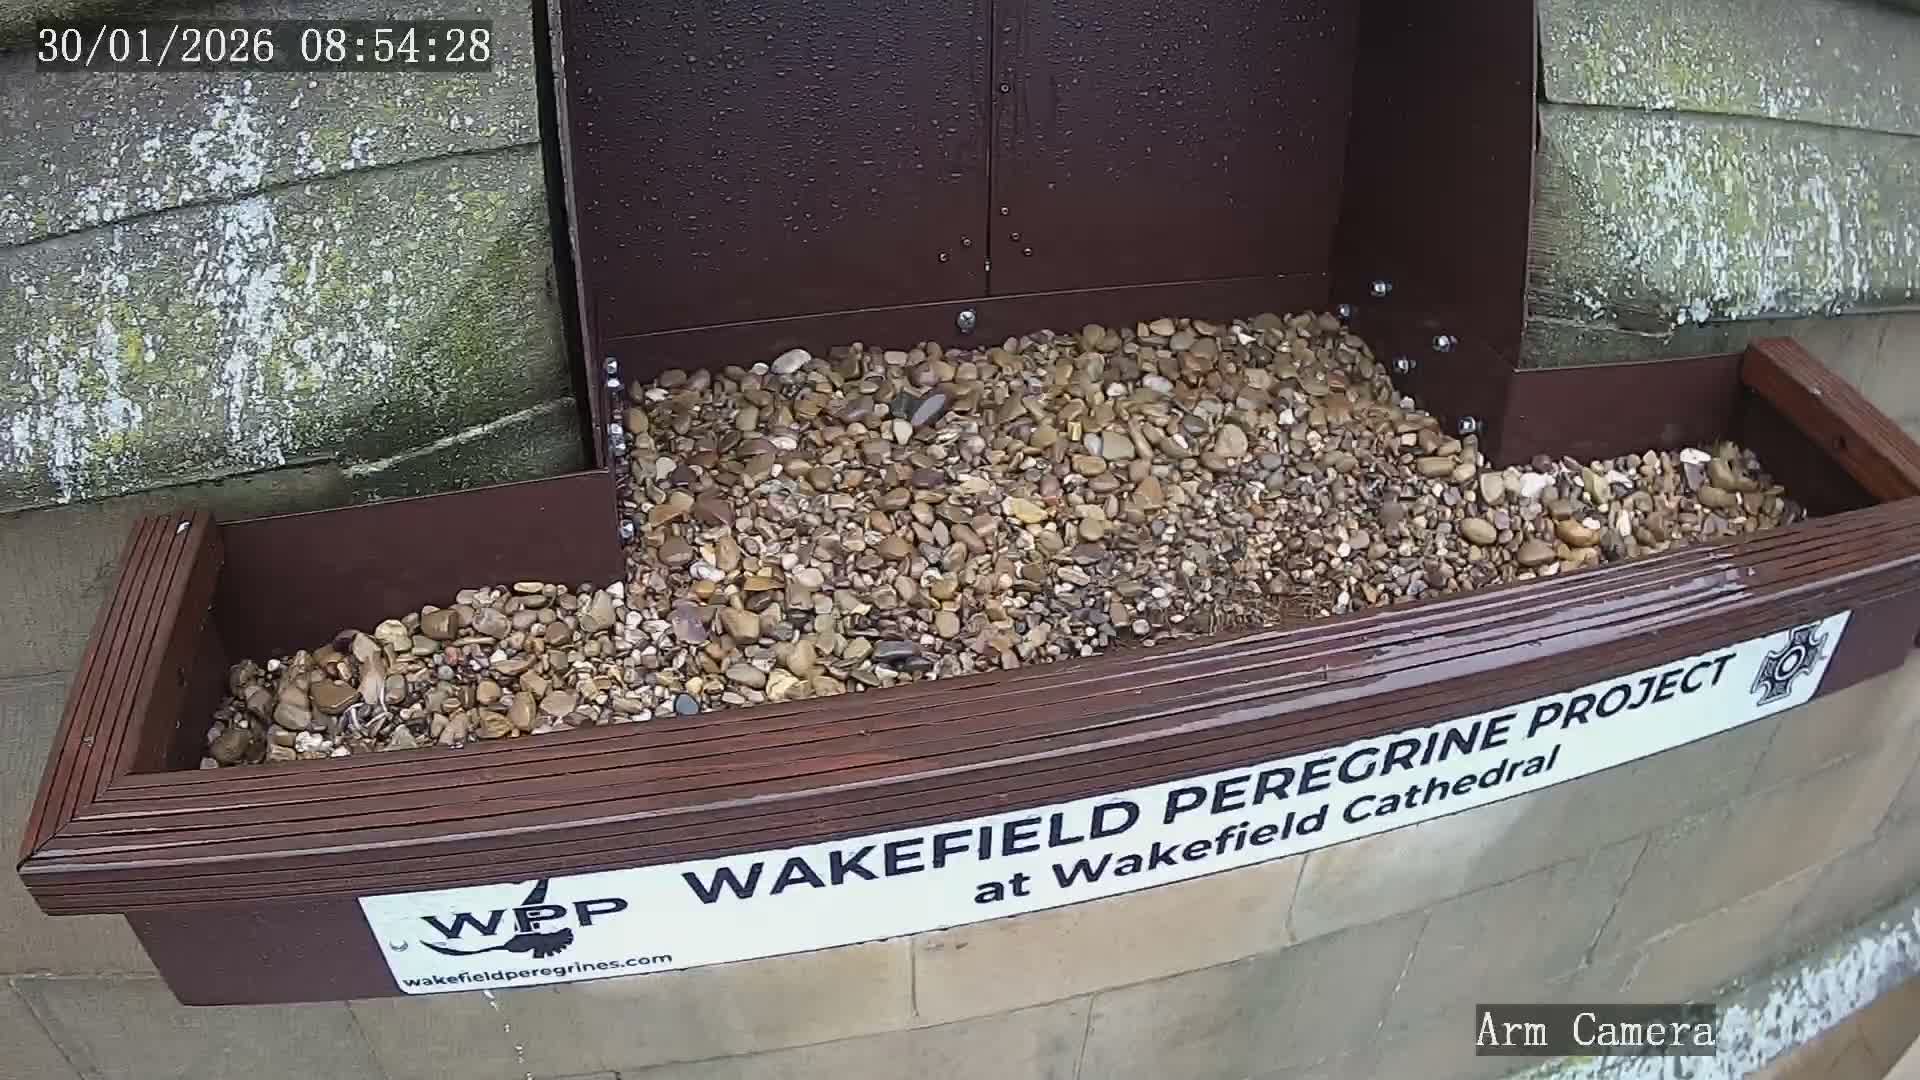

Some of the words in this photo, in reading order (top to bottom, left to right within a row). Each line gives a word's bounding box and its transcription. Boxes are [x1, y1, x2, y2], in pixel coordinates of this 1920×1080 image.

[681, 801, 1140, 904] WAKEFIELD
[1163, 713, 1516, 824] PEREGRINE
[1527, 654, 1736, 738] PROJECT
[974, 872, 1031, 904] at
[1052, 804, 1329, 888] Wakefield
[1343, 744, 1561, 824] Cathedral
[421, 898, 629, 940] WPP
[402, 953, 673, 988] wakefieldperegrines.com
